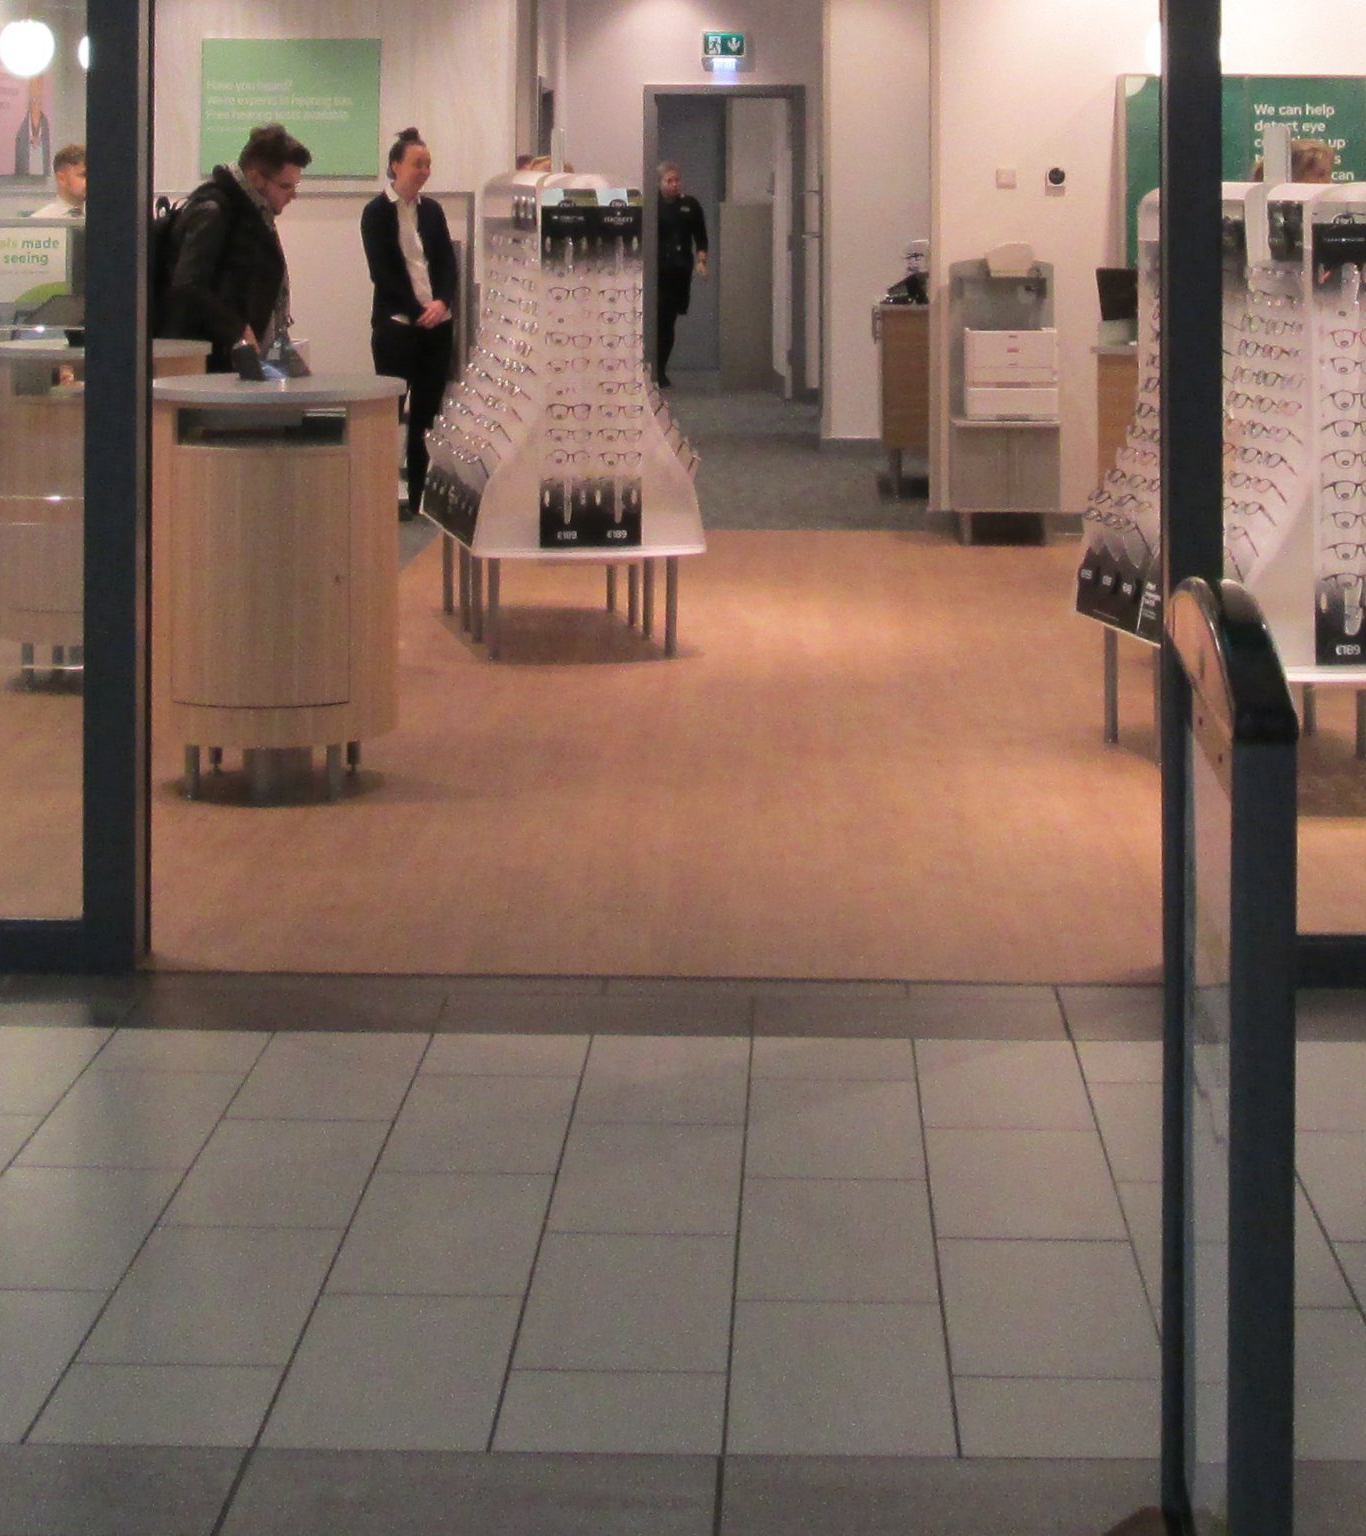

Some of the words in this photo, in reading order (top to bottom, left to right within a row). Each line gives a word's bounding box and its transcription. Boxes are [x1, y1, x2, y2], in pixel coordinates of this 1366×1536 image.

[1254, 103, 1275, 116] We
[1278, 106, 1302, 116] can
[1305, 103, 1335, 118] help
[1302, 122, 1326, 134] eye
[1328, 138, 1346, 150] up
[1330, 170, 1354, 181] can
[21, 237, 59, 249] made
[3, 251, 49, 265] seeing
